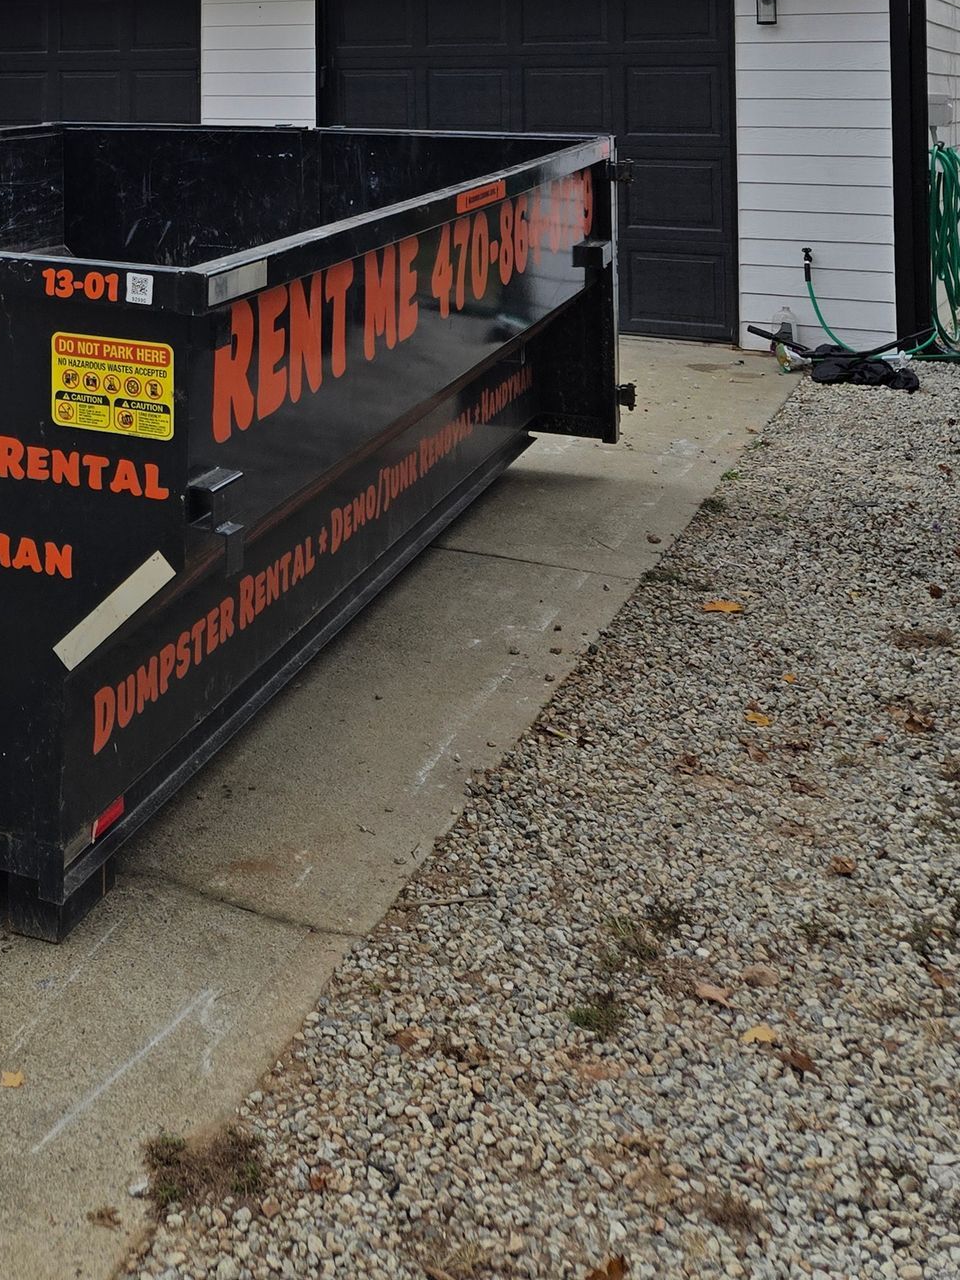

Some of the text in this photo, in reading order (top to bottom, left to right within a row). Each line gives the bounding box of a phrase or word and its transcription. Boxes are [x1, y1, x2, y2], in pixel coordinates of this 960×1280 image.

[42, 268, 118, 301] 13-01
[59, 339, 166, 364] DO NOT PARK HERE
[212, 261, 354, 443] RENT
[364, 236, 419, 361] ME
[58, 358, 167, 379] NO HAZARDOUS WASTES ACCEPTED
[71, 393, 102, 404] CAUTION
[131, 401, 163, 412] CAUTION
[93, 597, 233, 752] DUMPSTER
[240, 539, 315, 629] RENTAL
[331, 451, 417, 555] DEMO/JUNK
